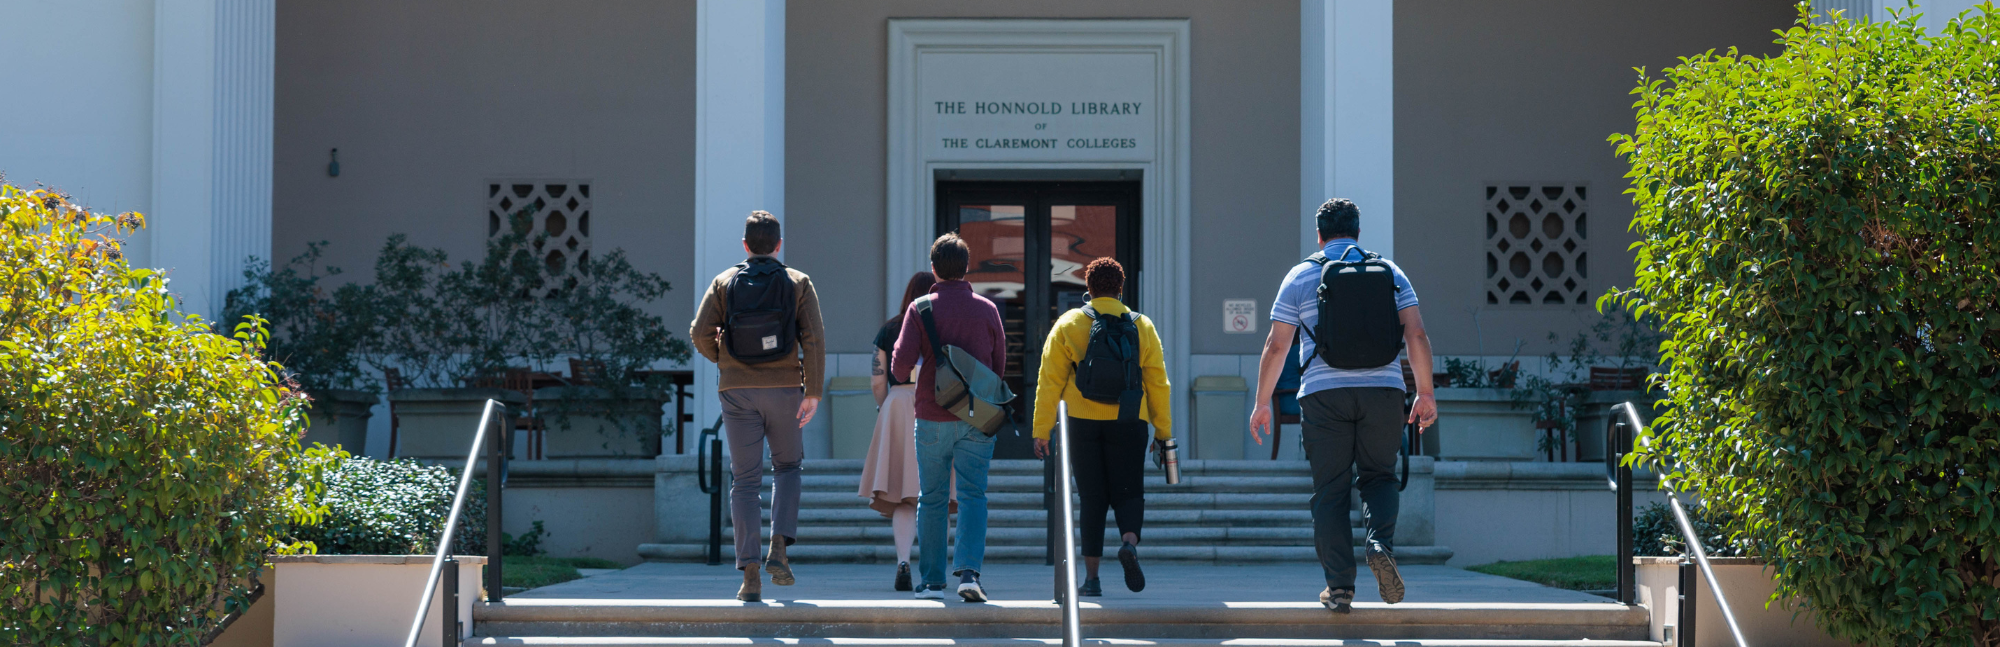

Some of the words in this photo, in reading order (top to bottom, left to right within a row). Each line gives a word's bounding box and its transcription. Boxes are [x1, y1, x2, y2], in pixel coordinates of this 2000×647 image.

[934, 101, 966, 114] THE
[975, 101, 1062, 114] HONNOLD
[1071, 102, 1142, 115] LIBRARY
[942, 138, 968, 148] THE
[975, 138, 1058, 148] CLAREMONT
[1066, 138, 1137, 148] COLLEGES
